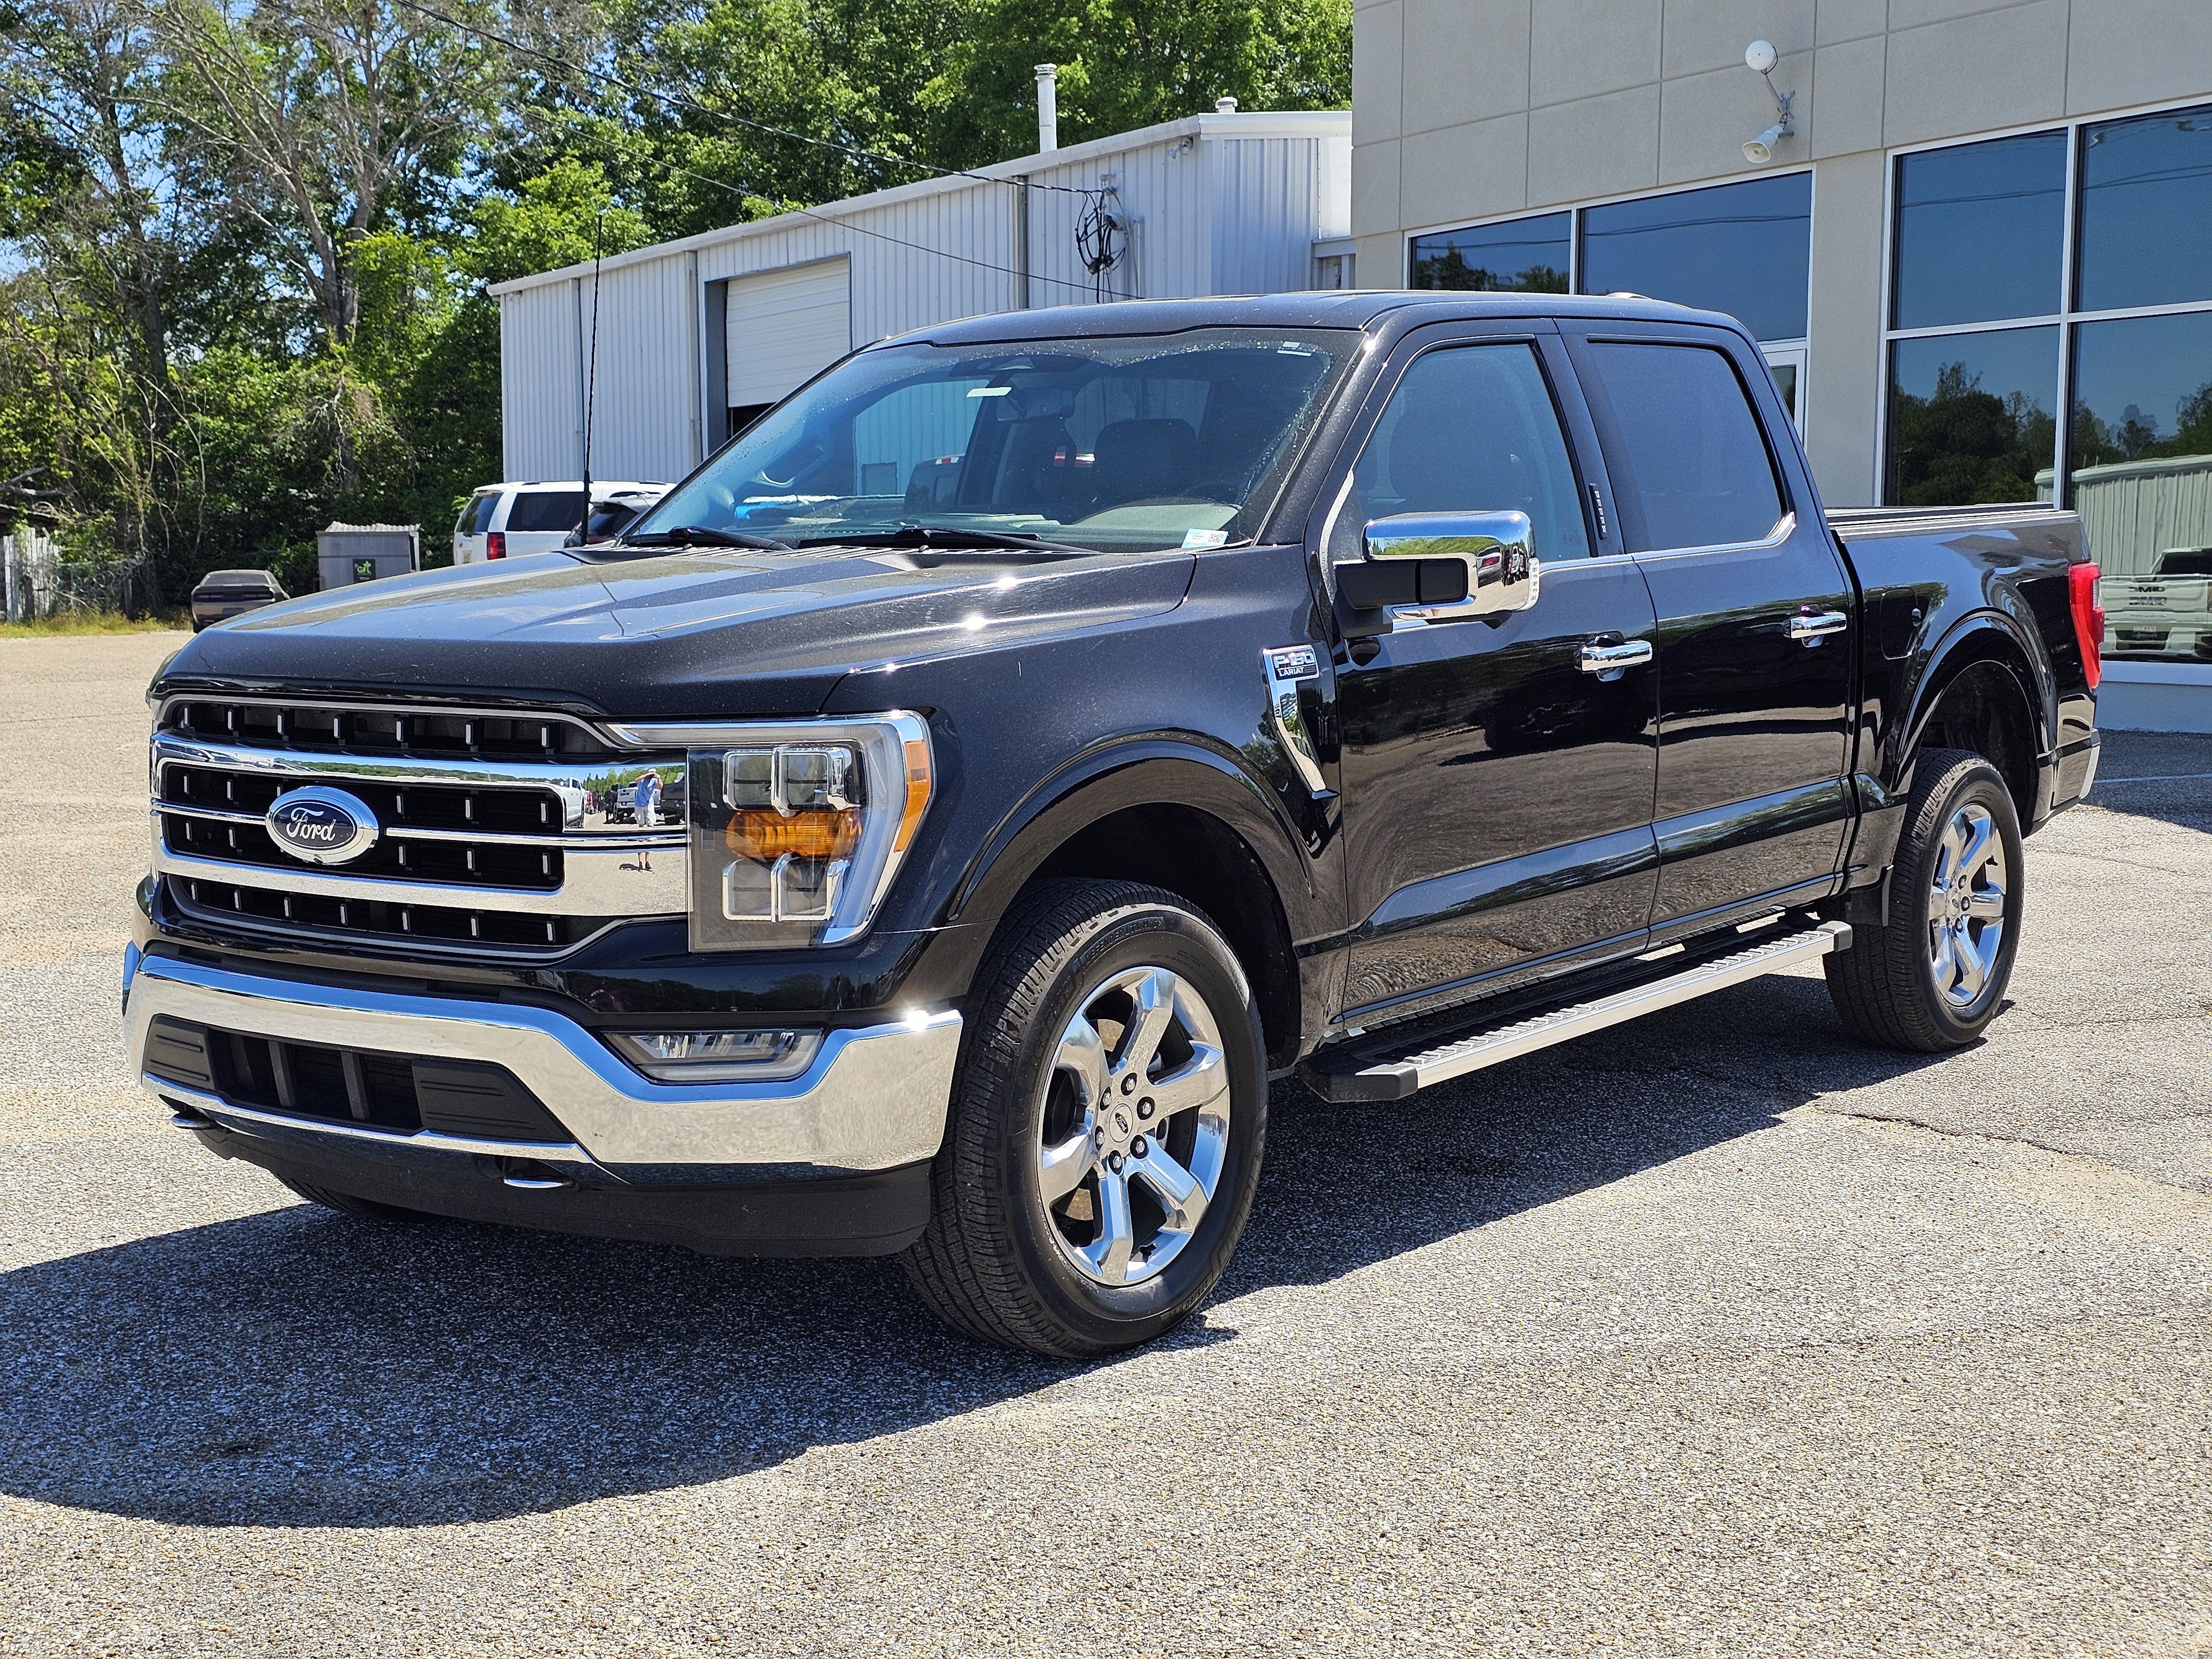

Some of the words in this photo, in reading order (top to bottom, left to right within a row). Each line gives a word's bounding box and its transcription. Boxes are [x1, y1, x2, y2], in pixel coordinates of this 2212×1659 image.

[1277, 666, 1304, 676] LARIAT
[286, 807, 337, 841] Ford
[1084, 927, 1125, 964] DEFENDER
